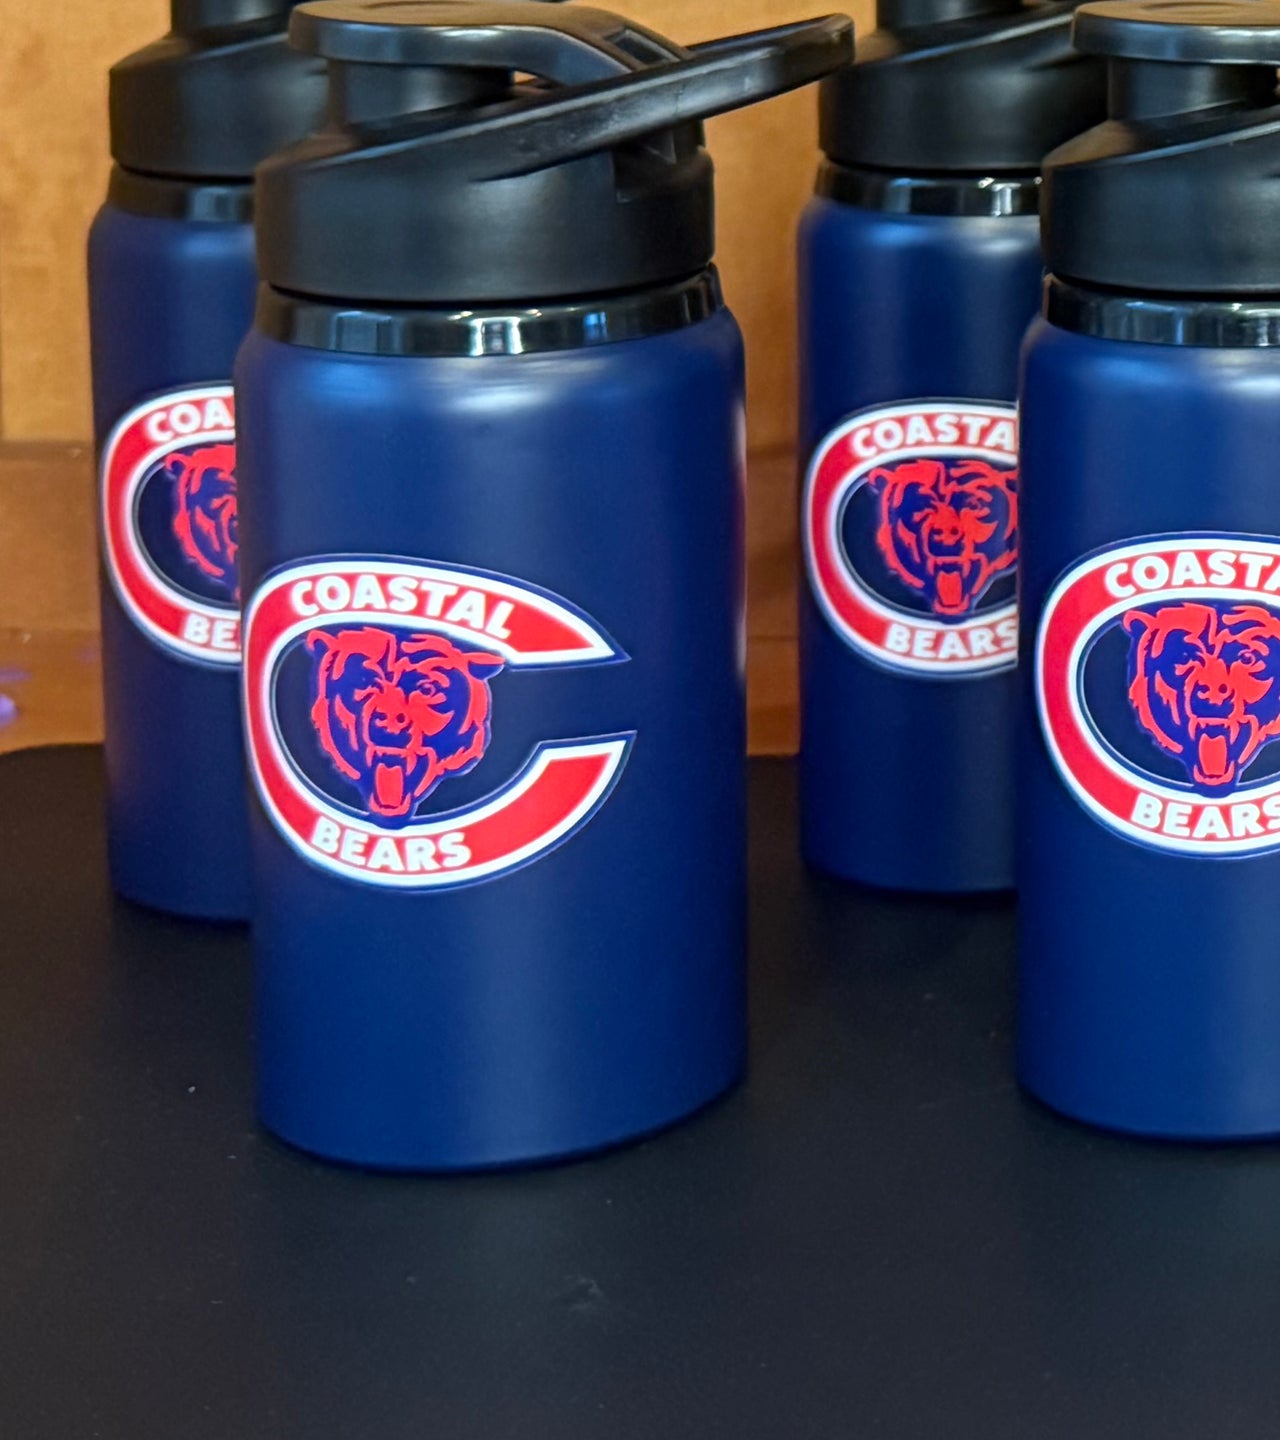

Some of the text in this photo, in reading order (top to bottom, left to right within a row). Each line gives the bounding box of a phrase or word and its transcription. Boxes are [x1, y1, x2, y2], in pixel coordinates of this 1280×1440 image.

[852, 414, 1016, 457] COASTA
[291, 574, 512, 639] COASTAL
[311, 817, 472, 874] BEARS
